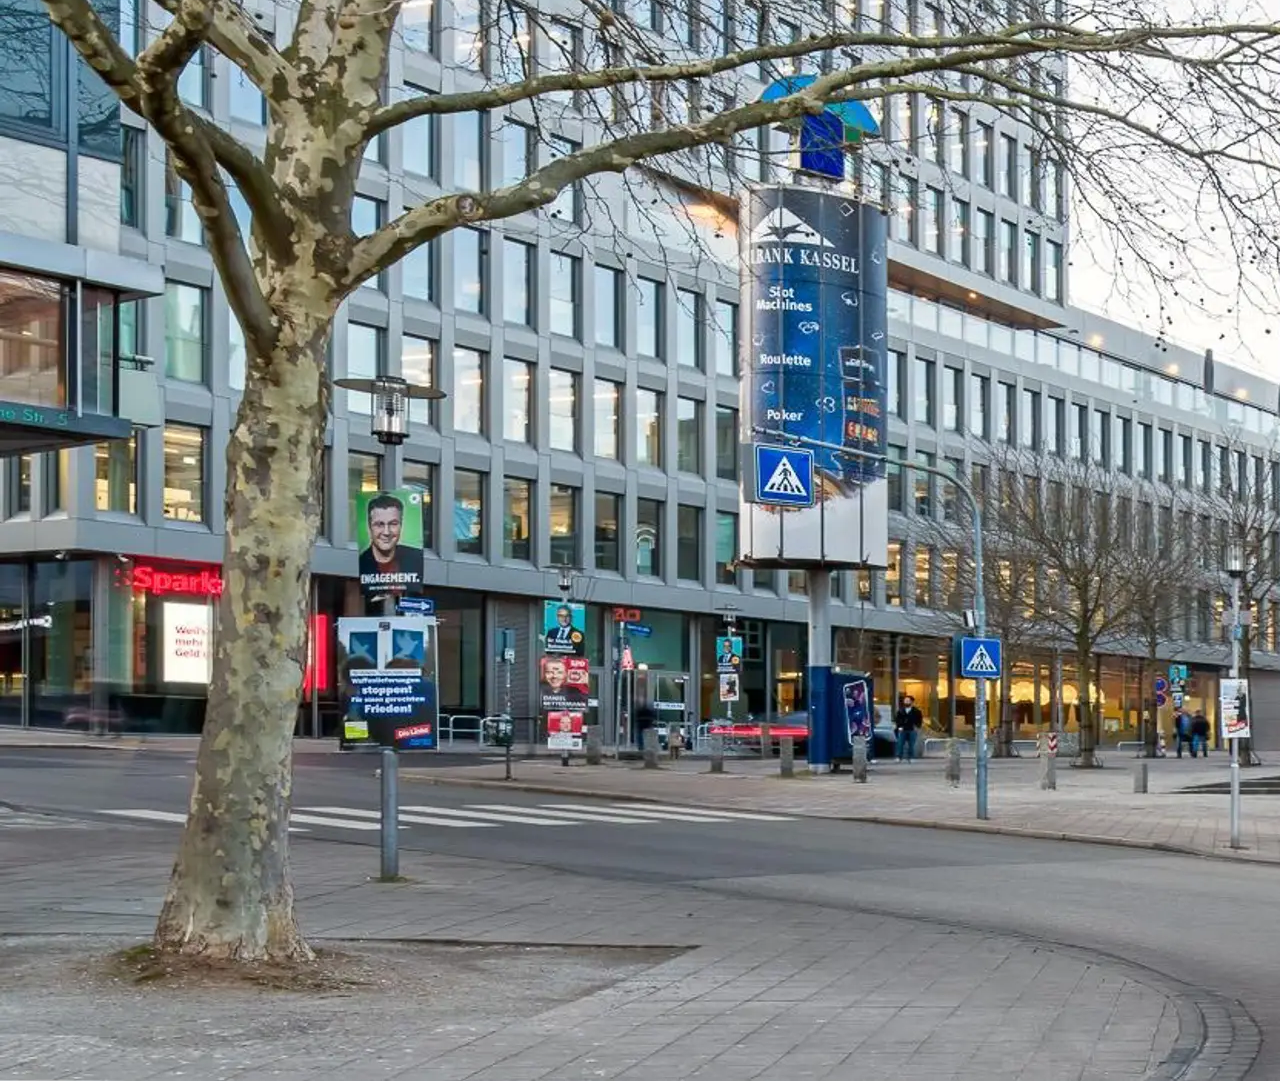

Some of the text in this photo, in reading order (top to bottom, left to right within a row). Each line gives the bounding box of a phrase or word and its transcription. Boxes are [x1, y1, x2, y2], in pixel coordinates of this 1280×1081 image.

[800, 249, 860, 274] KASSEL
[769, 286, 795, 298] Slot
[756, 300, 813, 312] Machines
[760, 353, 812, 366] Roulette
[767, 409, 803, 421] Poker
[361, 572, 420, 584] ENGAGEMENT.
[362, 685, 412, 696] stoppen!
[364, 704, 412, 714] Frieden!
